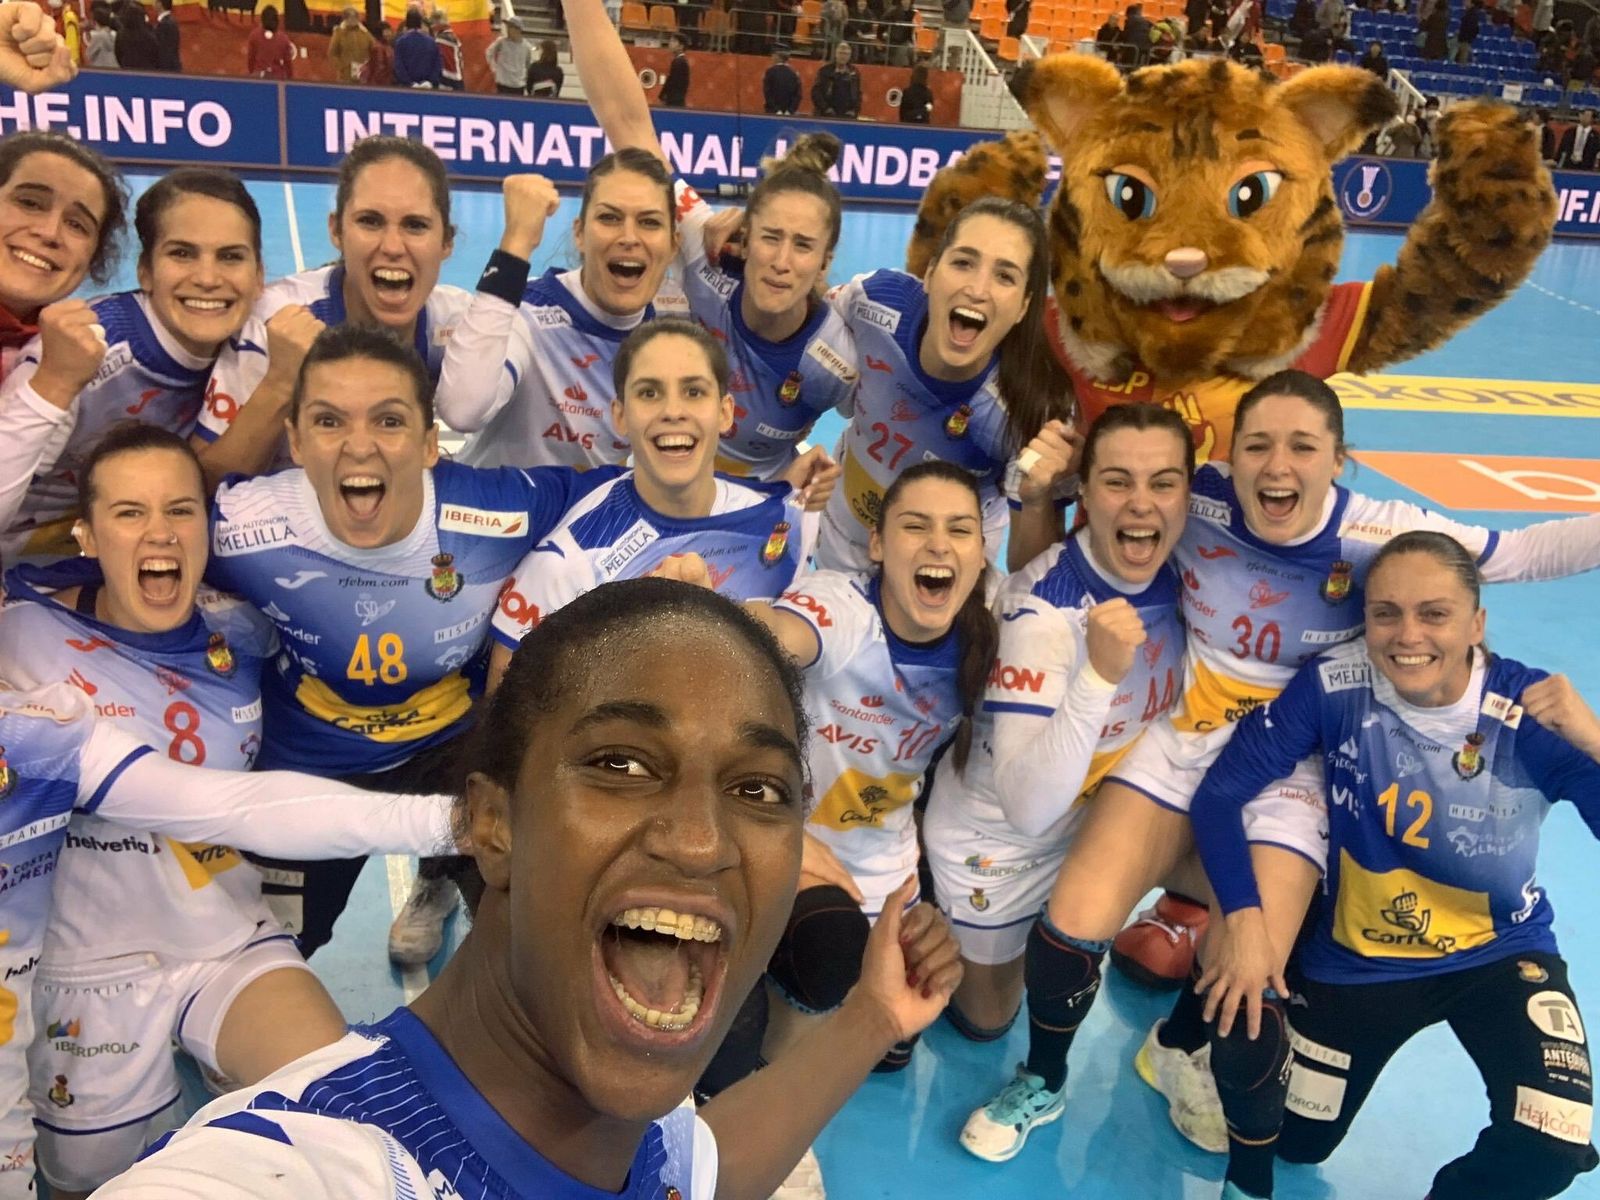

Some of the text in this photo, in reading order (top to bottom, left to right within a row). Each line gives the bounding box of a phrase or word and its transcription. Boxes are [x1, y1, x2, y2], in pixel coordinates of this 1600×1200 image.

[325, 108, 757, 178] INTERNATNAL
[867, 422, 914, 470] 27
[445, 509, 502, 529] IBERIA
[1189, 502, 1228, 522] ELILLA
[217, 525, 298, 553] MELILLA
[605, 532, 654, 576] MELILLA
[1228, 614, 1282, 664] 30
[346, 632, 408, 686] 48
[831, 699, 897, 726] Santander
[164, 701, 206, 767] 8
[816, 724, 881, 755] AVIS
[1376, 782, 1433, 849] 12
[66, 832, 149, 855] helvetia
[13, 851, 53, 875] COSTA
[55, 1041, 140, 1058] IBERDROLA
[1287, 1092, 1332, 1113] DROLA
